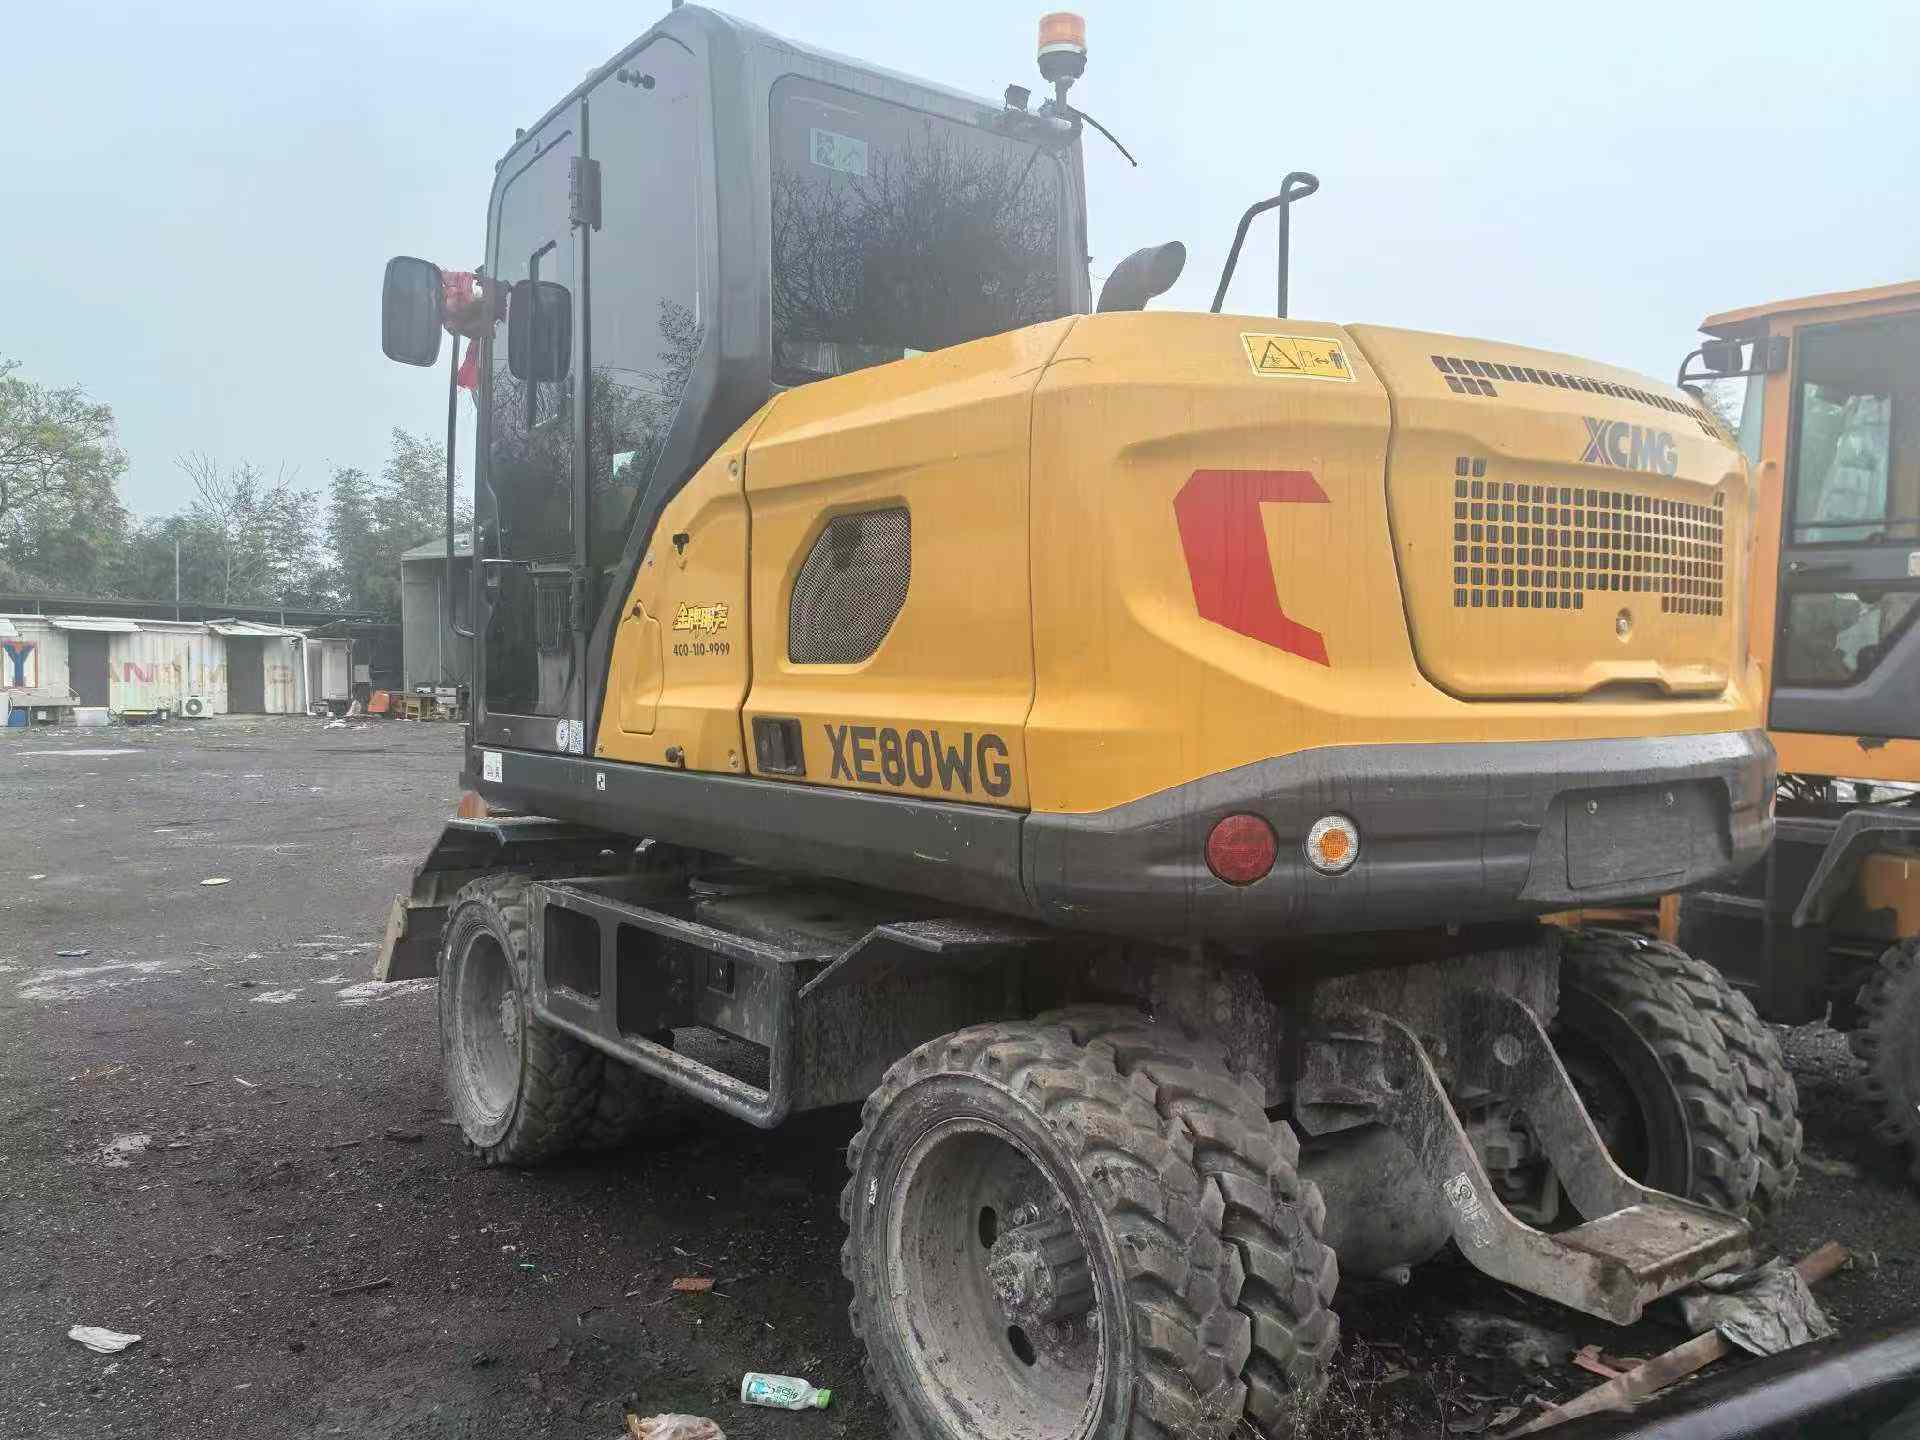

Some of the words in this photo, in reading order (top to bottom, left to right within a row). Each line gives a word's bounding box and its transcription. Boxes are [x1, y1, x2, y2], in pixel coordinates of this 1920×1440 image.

[1579, 416, 1679, 478] XCMG
[672, 642, 730, 656] 400-110-9999
[824, 724, 1012, 798] XE80WG
